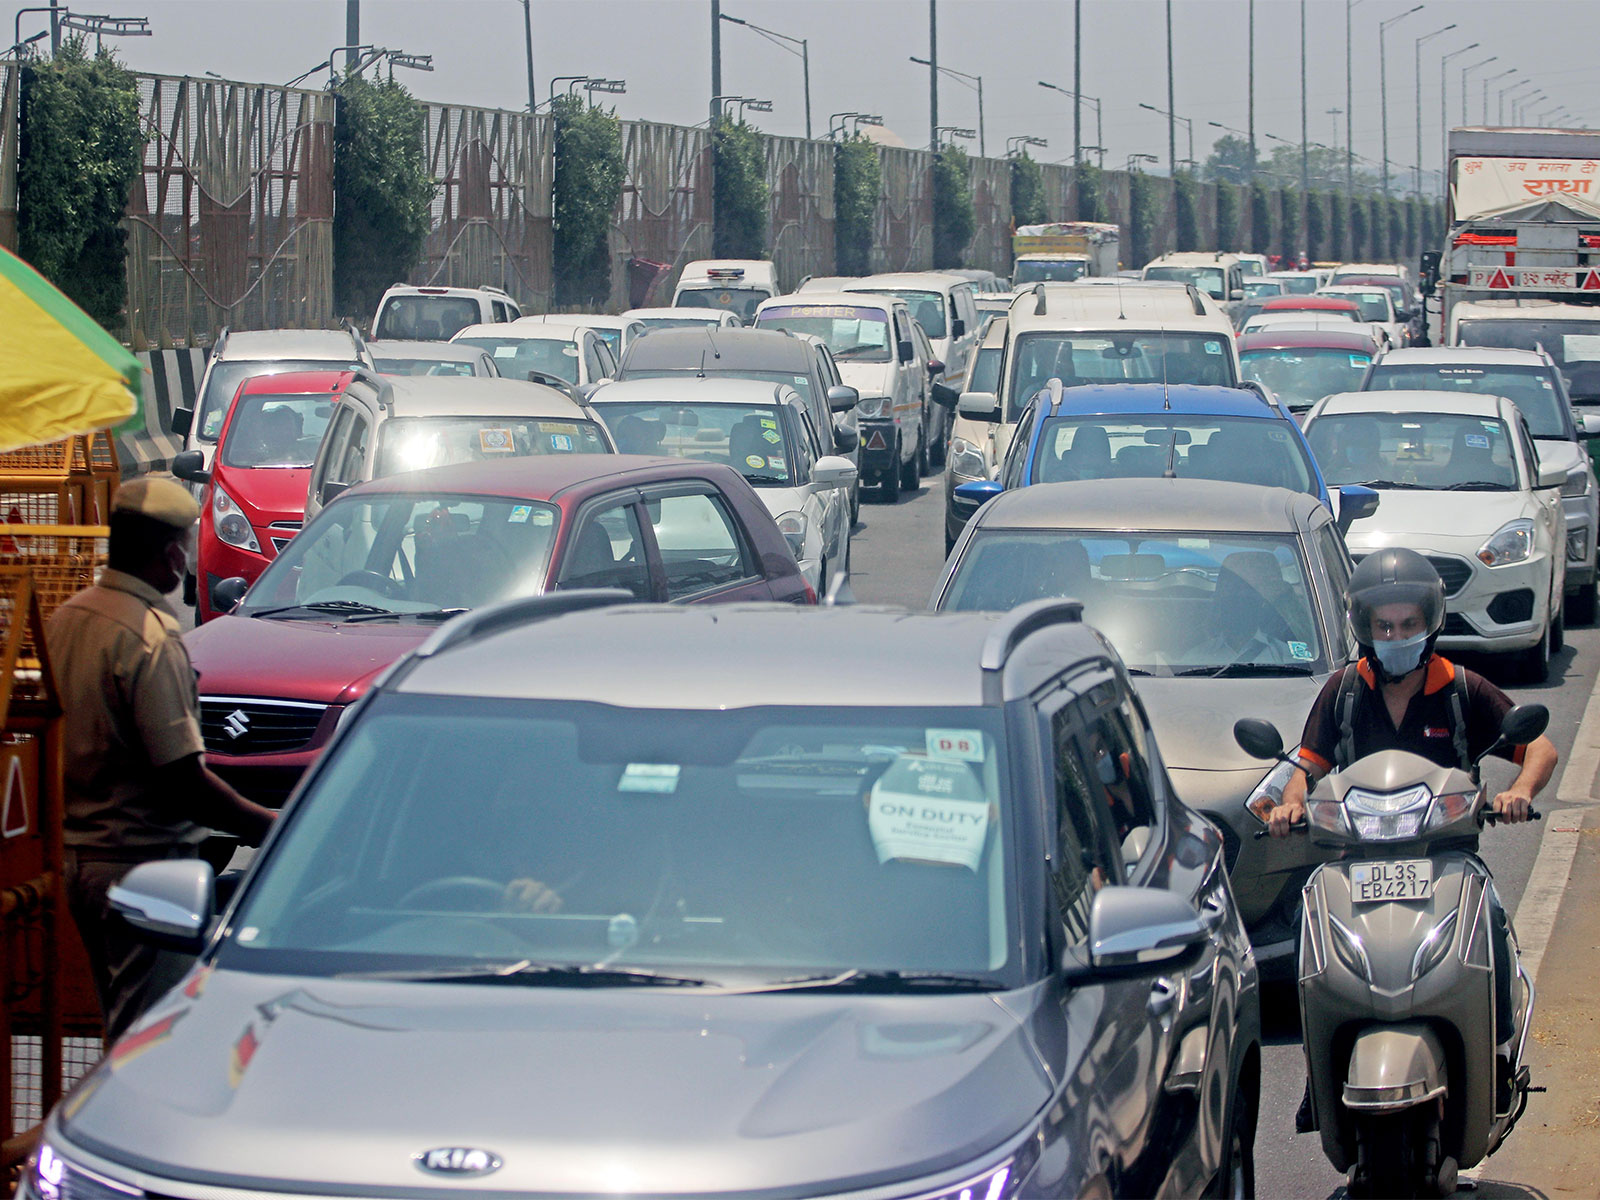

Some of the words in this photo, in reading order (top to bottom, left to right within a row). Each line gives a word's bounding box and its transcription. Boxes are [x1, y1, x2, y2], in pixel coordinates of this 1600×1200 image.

[791, 306, 856, 317] PORTER
[880, 804, 914, 817] ON
[921, 807, 984, 826] DUTY
[1371, 864, 1416, 882] DL3S
[1361, 880, 1429, 899] EB4217
[427, 1148, 488, 1169] KIA
